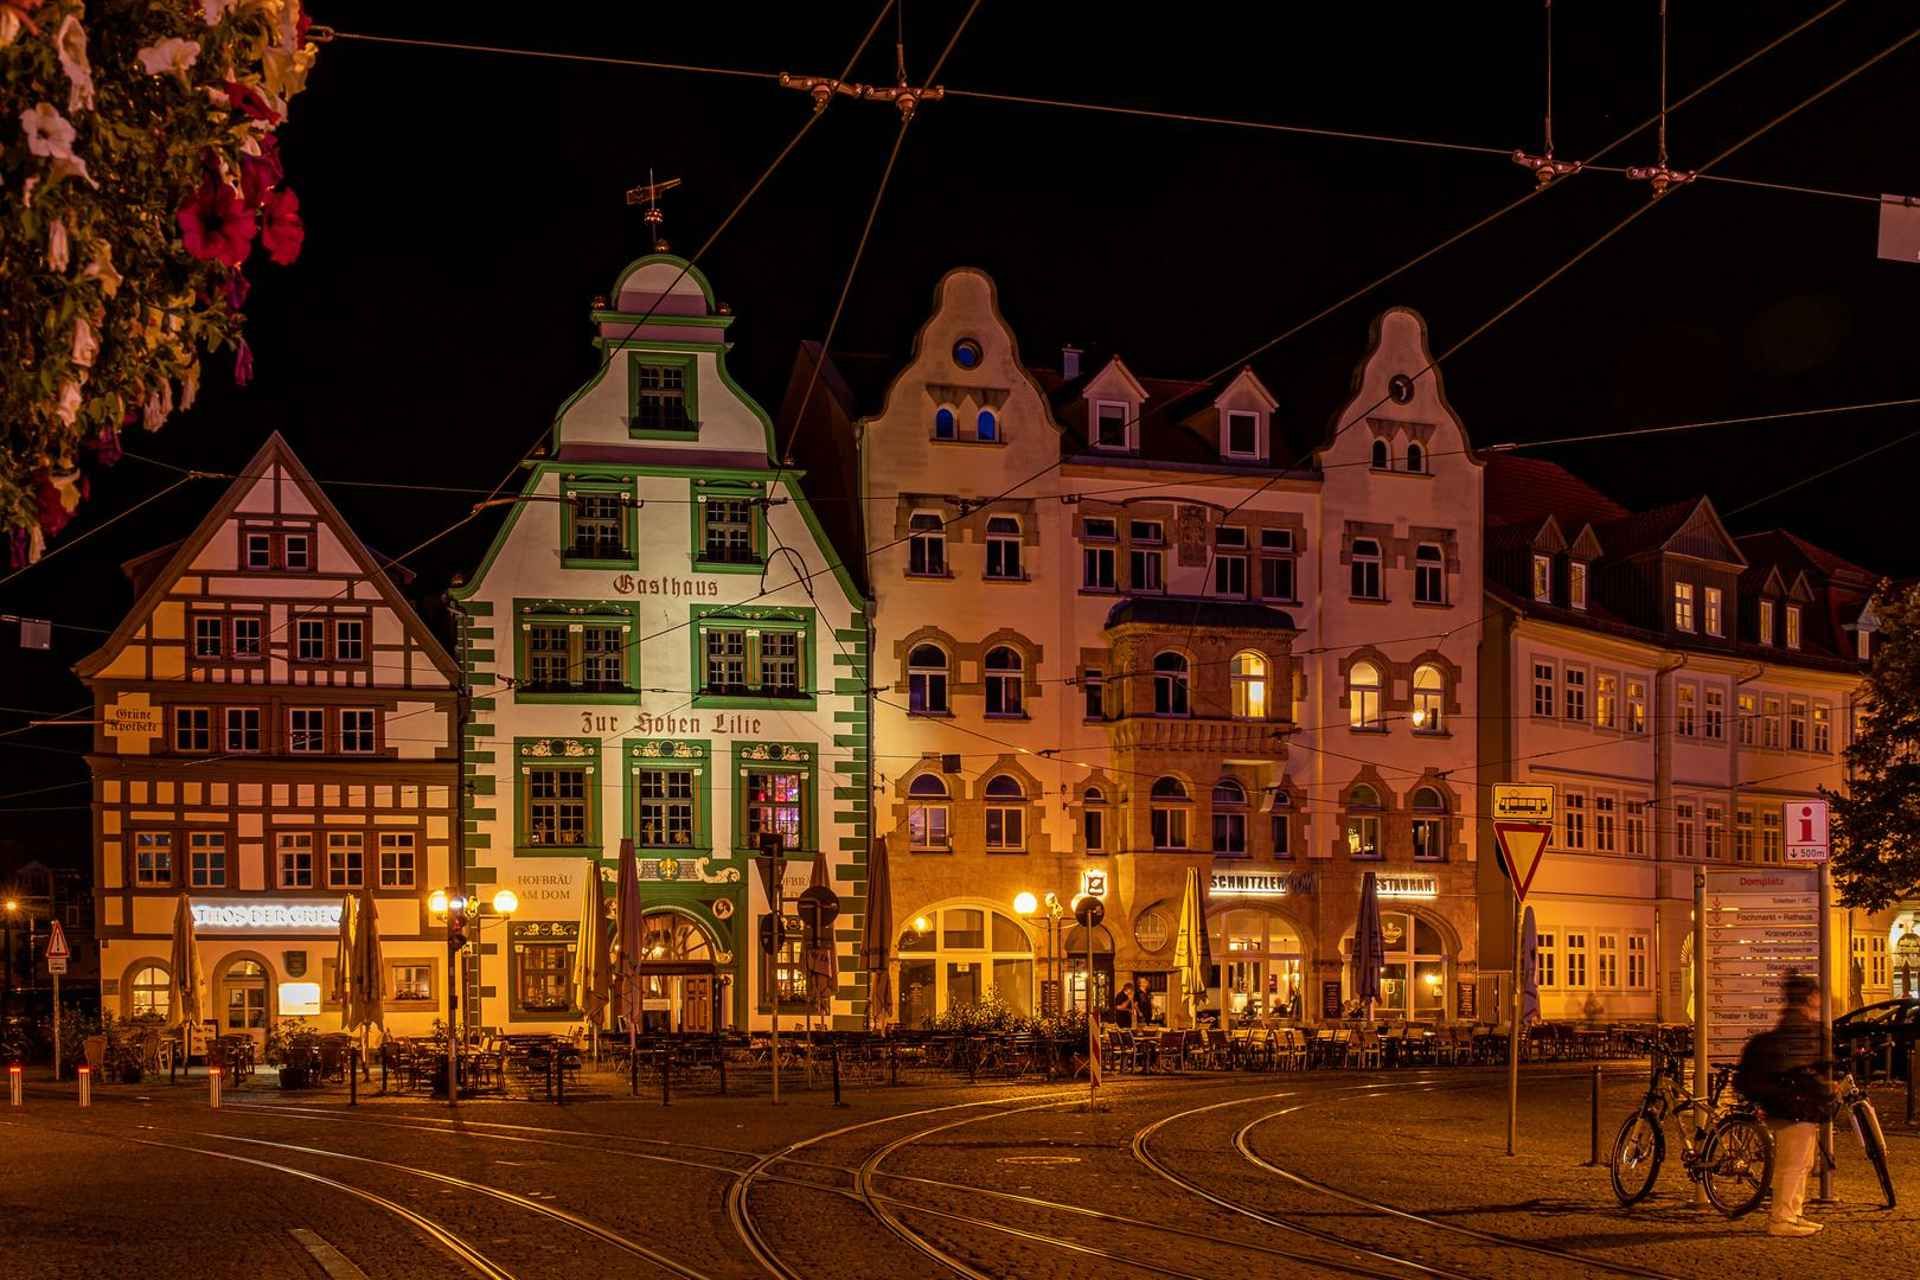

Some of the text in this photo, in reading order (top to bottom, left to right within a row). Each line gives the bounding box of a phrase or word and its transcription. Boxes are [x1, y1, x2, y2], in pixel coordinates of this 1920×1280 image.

[613, 574, 718, 597] Gasthaus
[116, 709, 151, 720] Grüne
[581, 711, 761, 736] Zur Hohen Lilie
[1801, 849, 1825, 858] 500m
[518, 873, 572, 885] HOFBRÄU
[1376, 878, 1439, 892] ESTAURANT
[1740, 877, 1784, 887] Domplatz
[542, 890, 570, 900] DOM
[289, 909, 339, 922] GRIEC
